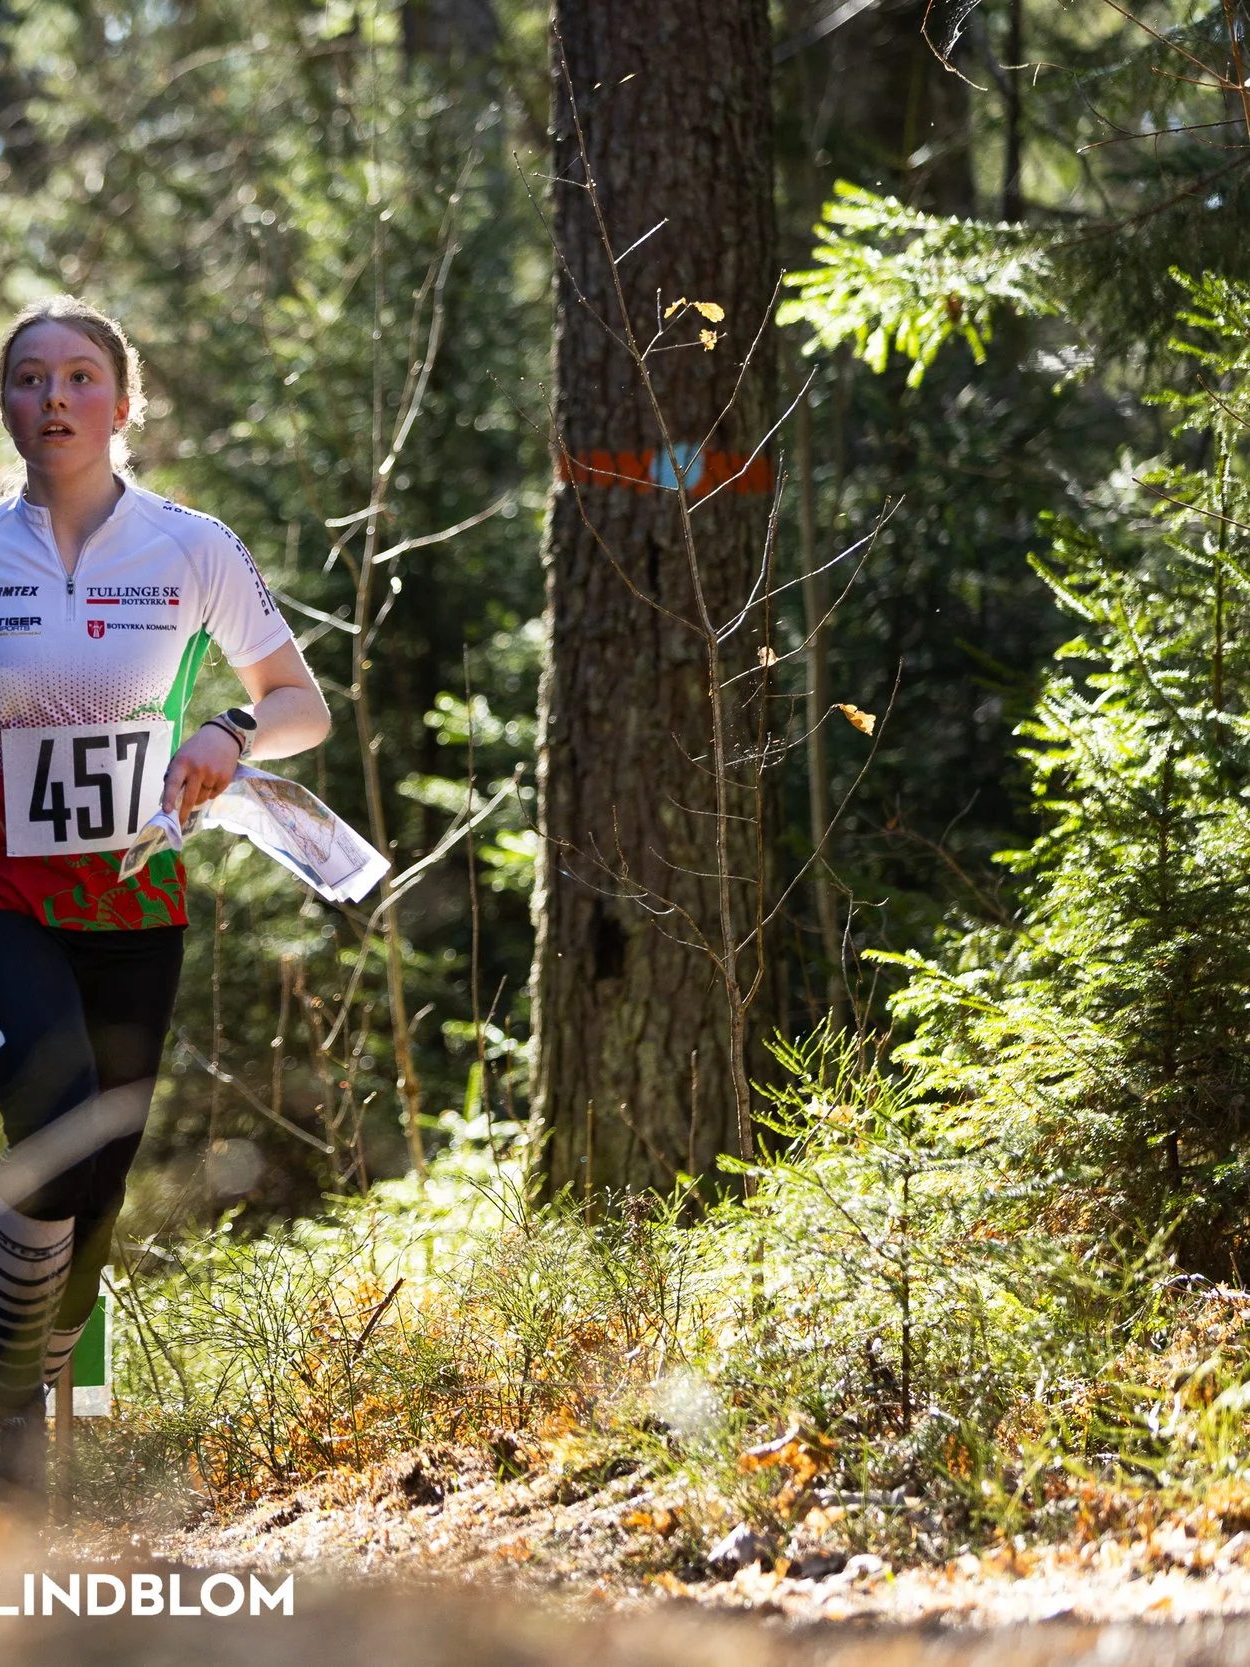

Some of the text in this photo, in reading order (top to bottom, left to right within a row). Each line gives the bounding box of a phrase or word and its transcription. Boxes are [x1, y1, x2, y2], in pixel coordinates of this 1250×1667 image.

[86, 587, 179, 597] TULLINGE SK
[121, 598, 167, 606] BOTKYRKA
[29, 731, 151, 843] 457
